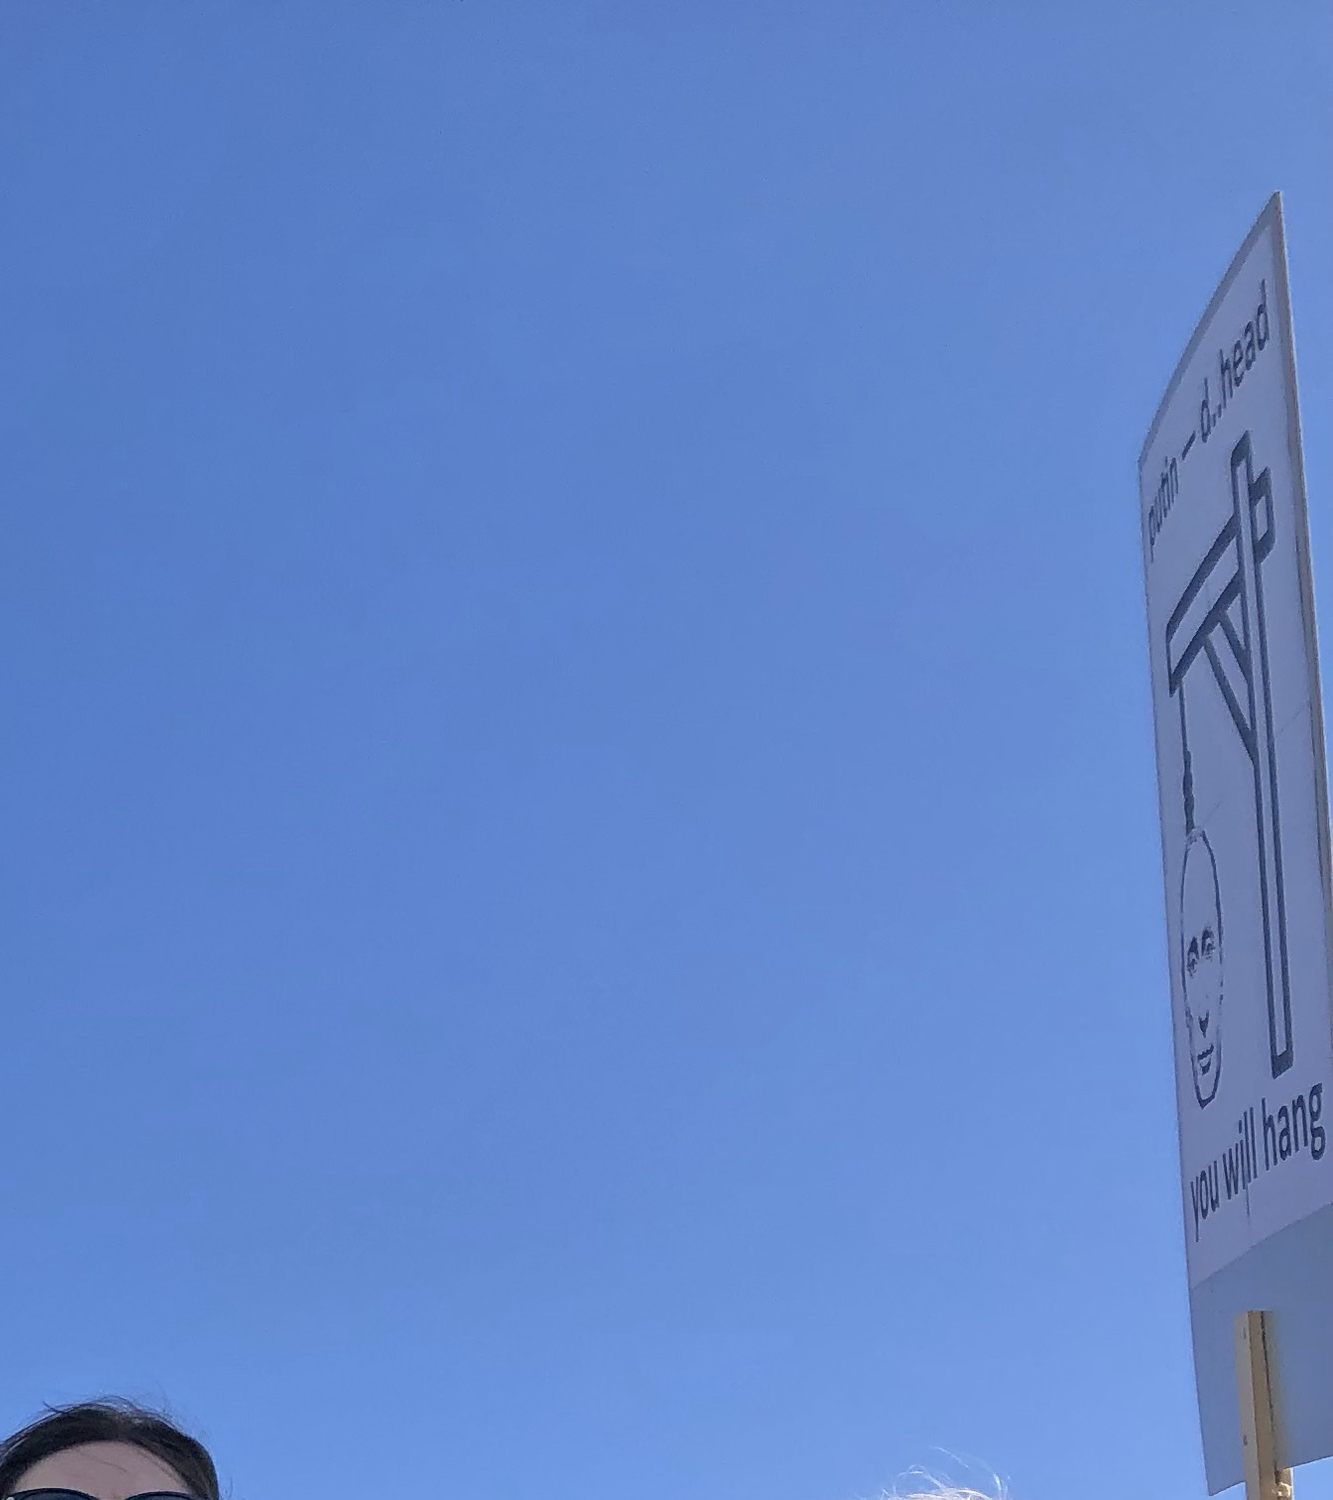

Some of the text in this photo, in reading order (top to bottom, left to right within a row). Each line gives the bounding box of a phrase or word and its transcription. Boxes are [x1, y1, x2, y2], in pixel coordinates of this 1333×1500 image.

[1147, 456, 1179, 564] putin
[1190, 1082, 1326, 1242] you will hang
